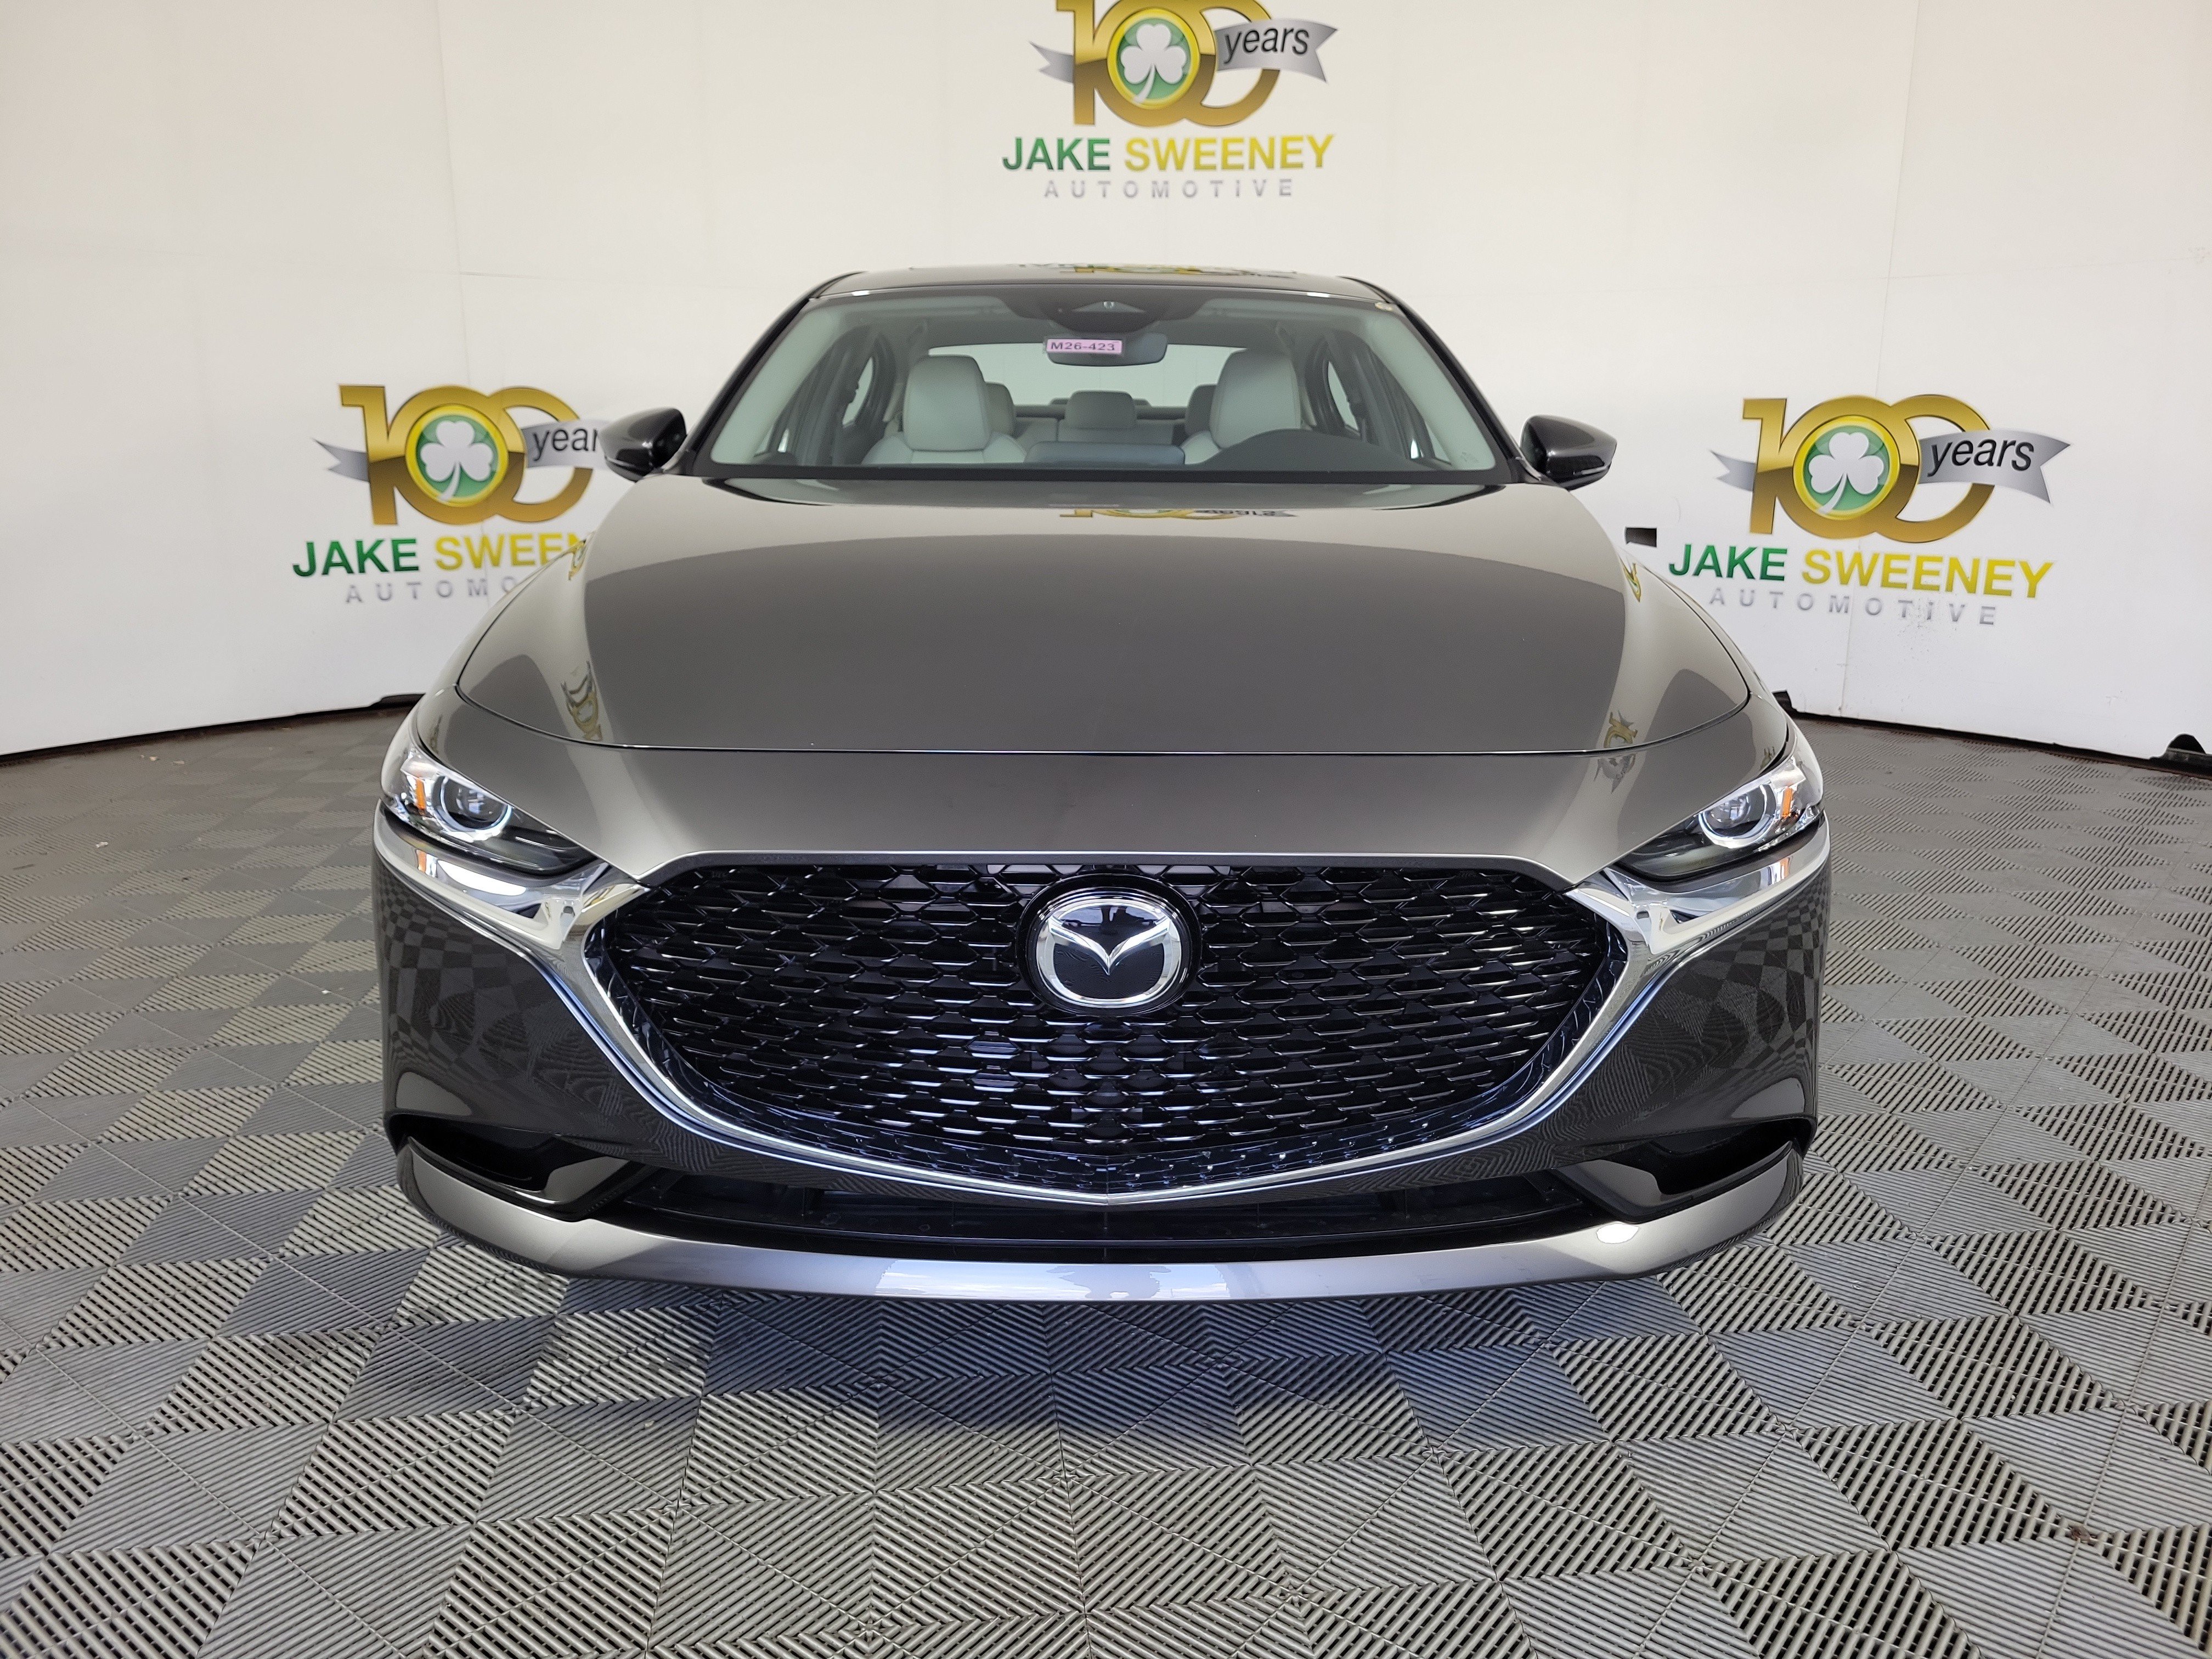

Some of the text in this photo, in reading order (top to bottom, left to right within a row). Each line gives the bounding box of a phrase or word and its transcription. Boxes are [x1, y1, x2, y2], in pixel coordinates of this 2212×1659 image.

[1223, 26, 1310, 65] years
[1002, 134, 1335, 171] JAKE SWEENEY
[1043, 178, 1293, 199] AUTOMOTIVE
[1051, 341, 1115, 351] M26-423
[1742, 394, 2034, 543] 100 years
[292, 537, 420, 578] JAKE
[1669, 544, 2055, 599] JAKE SWEENEY
[1709, 588, 1996, 626] AUTOMOTIVE
